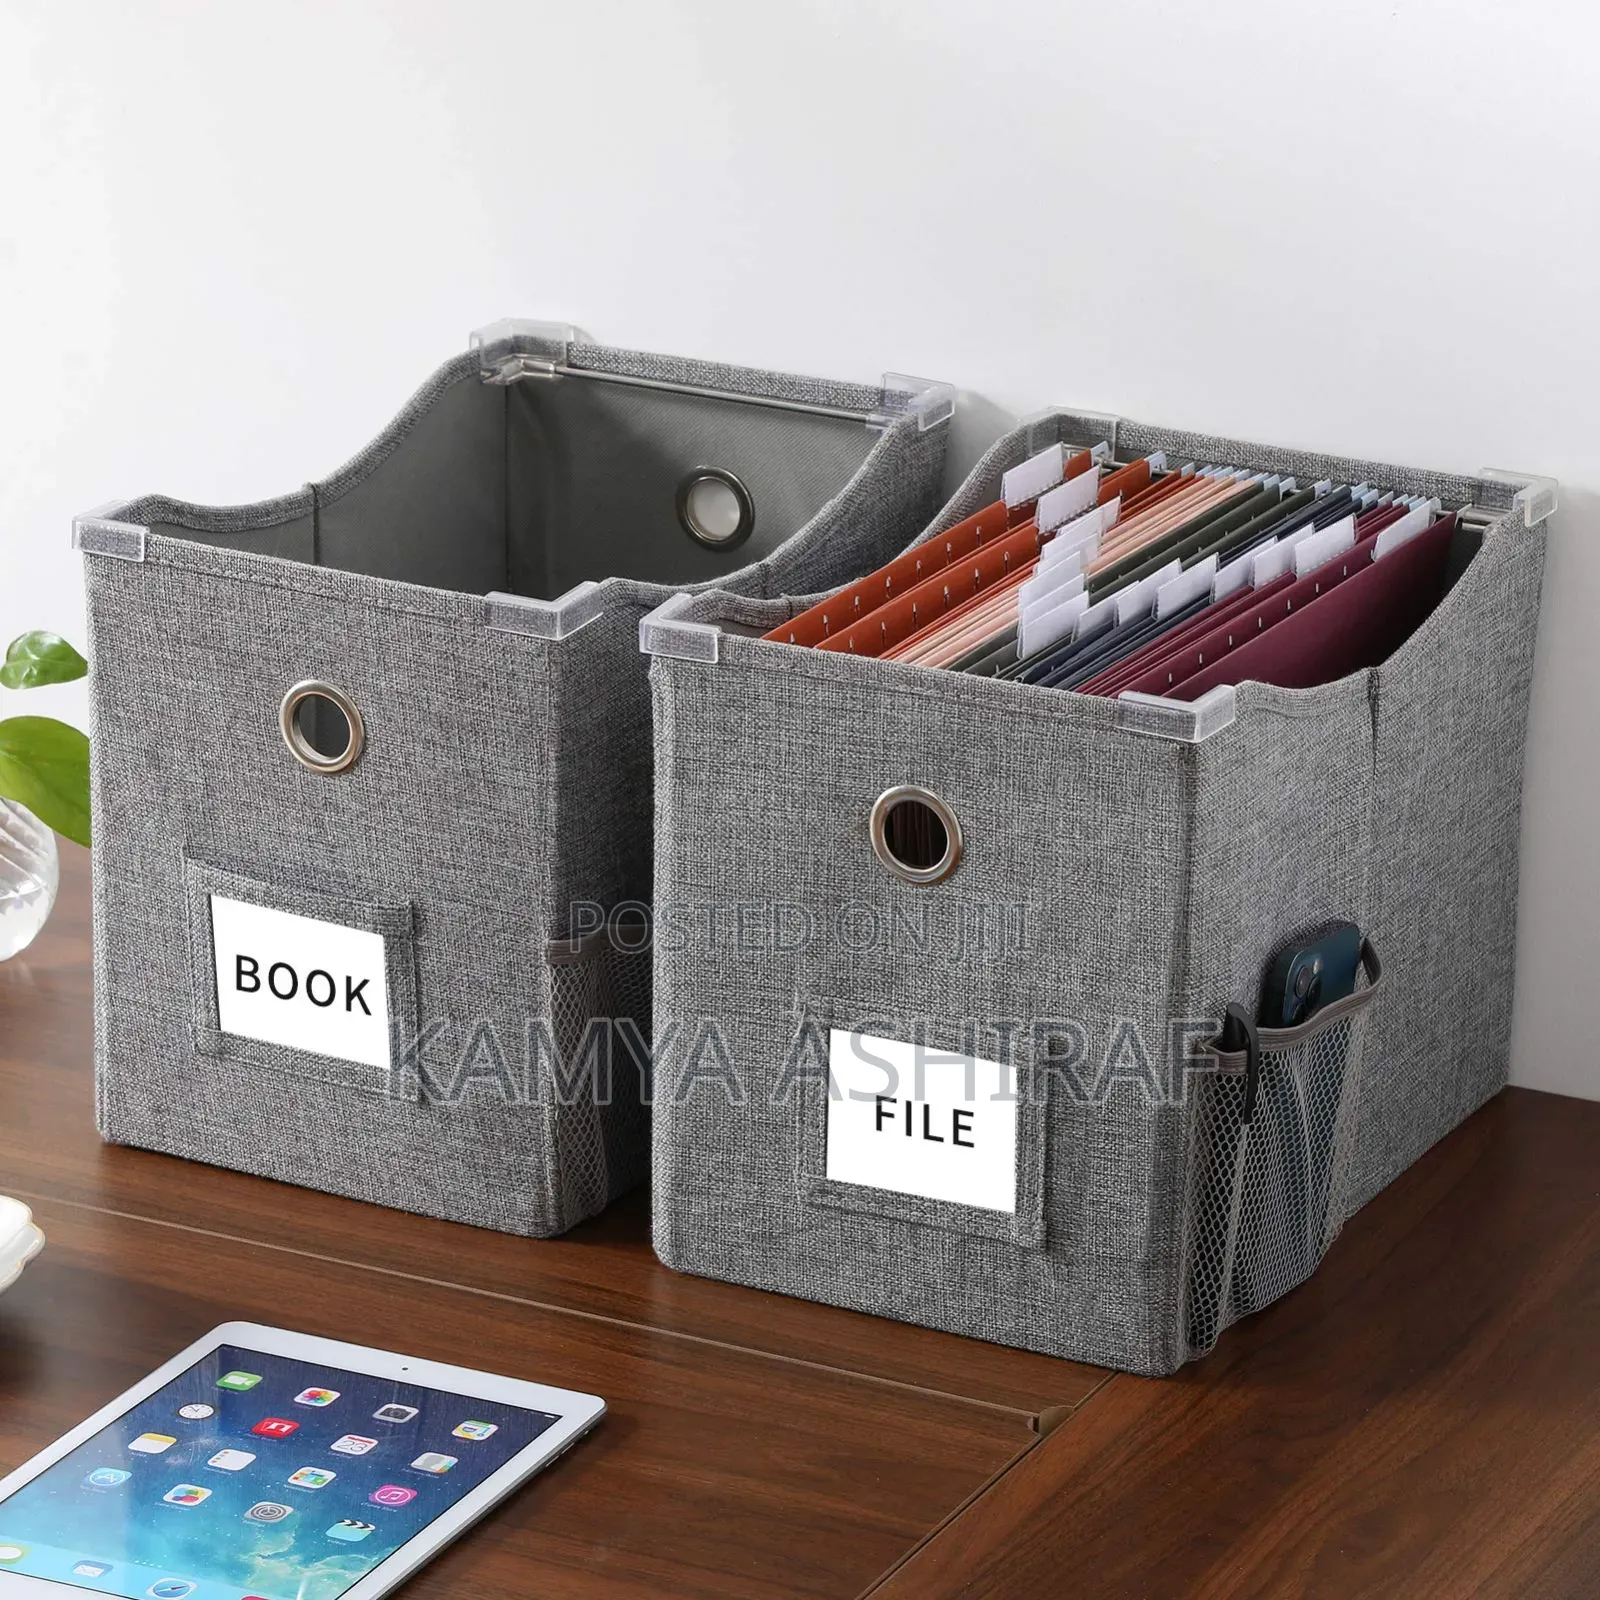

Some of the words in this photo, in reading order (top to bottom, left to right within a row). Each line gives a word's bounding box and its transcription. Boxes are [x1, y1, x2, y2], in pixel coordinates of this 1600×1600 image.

[235, 954, 372, 1016] BOOK
[875, 1094, 975, 1148] FILE
[337, 1439, 367, 1452] 23
